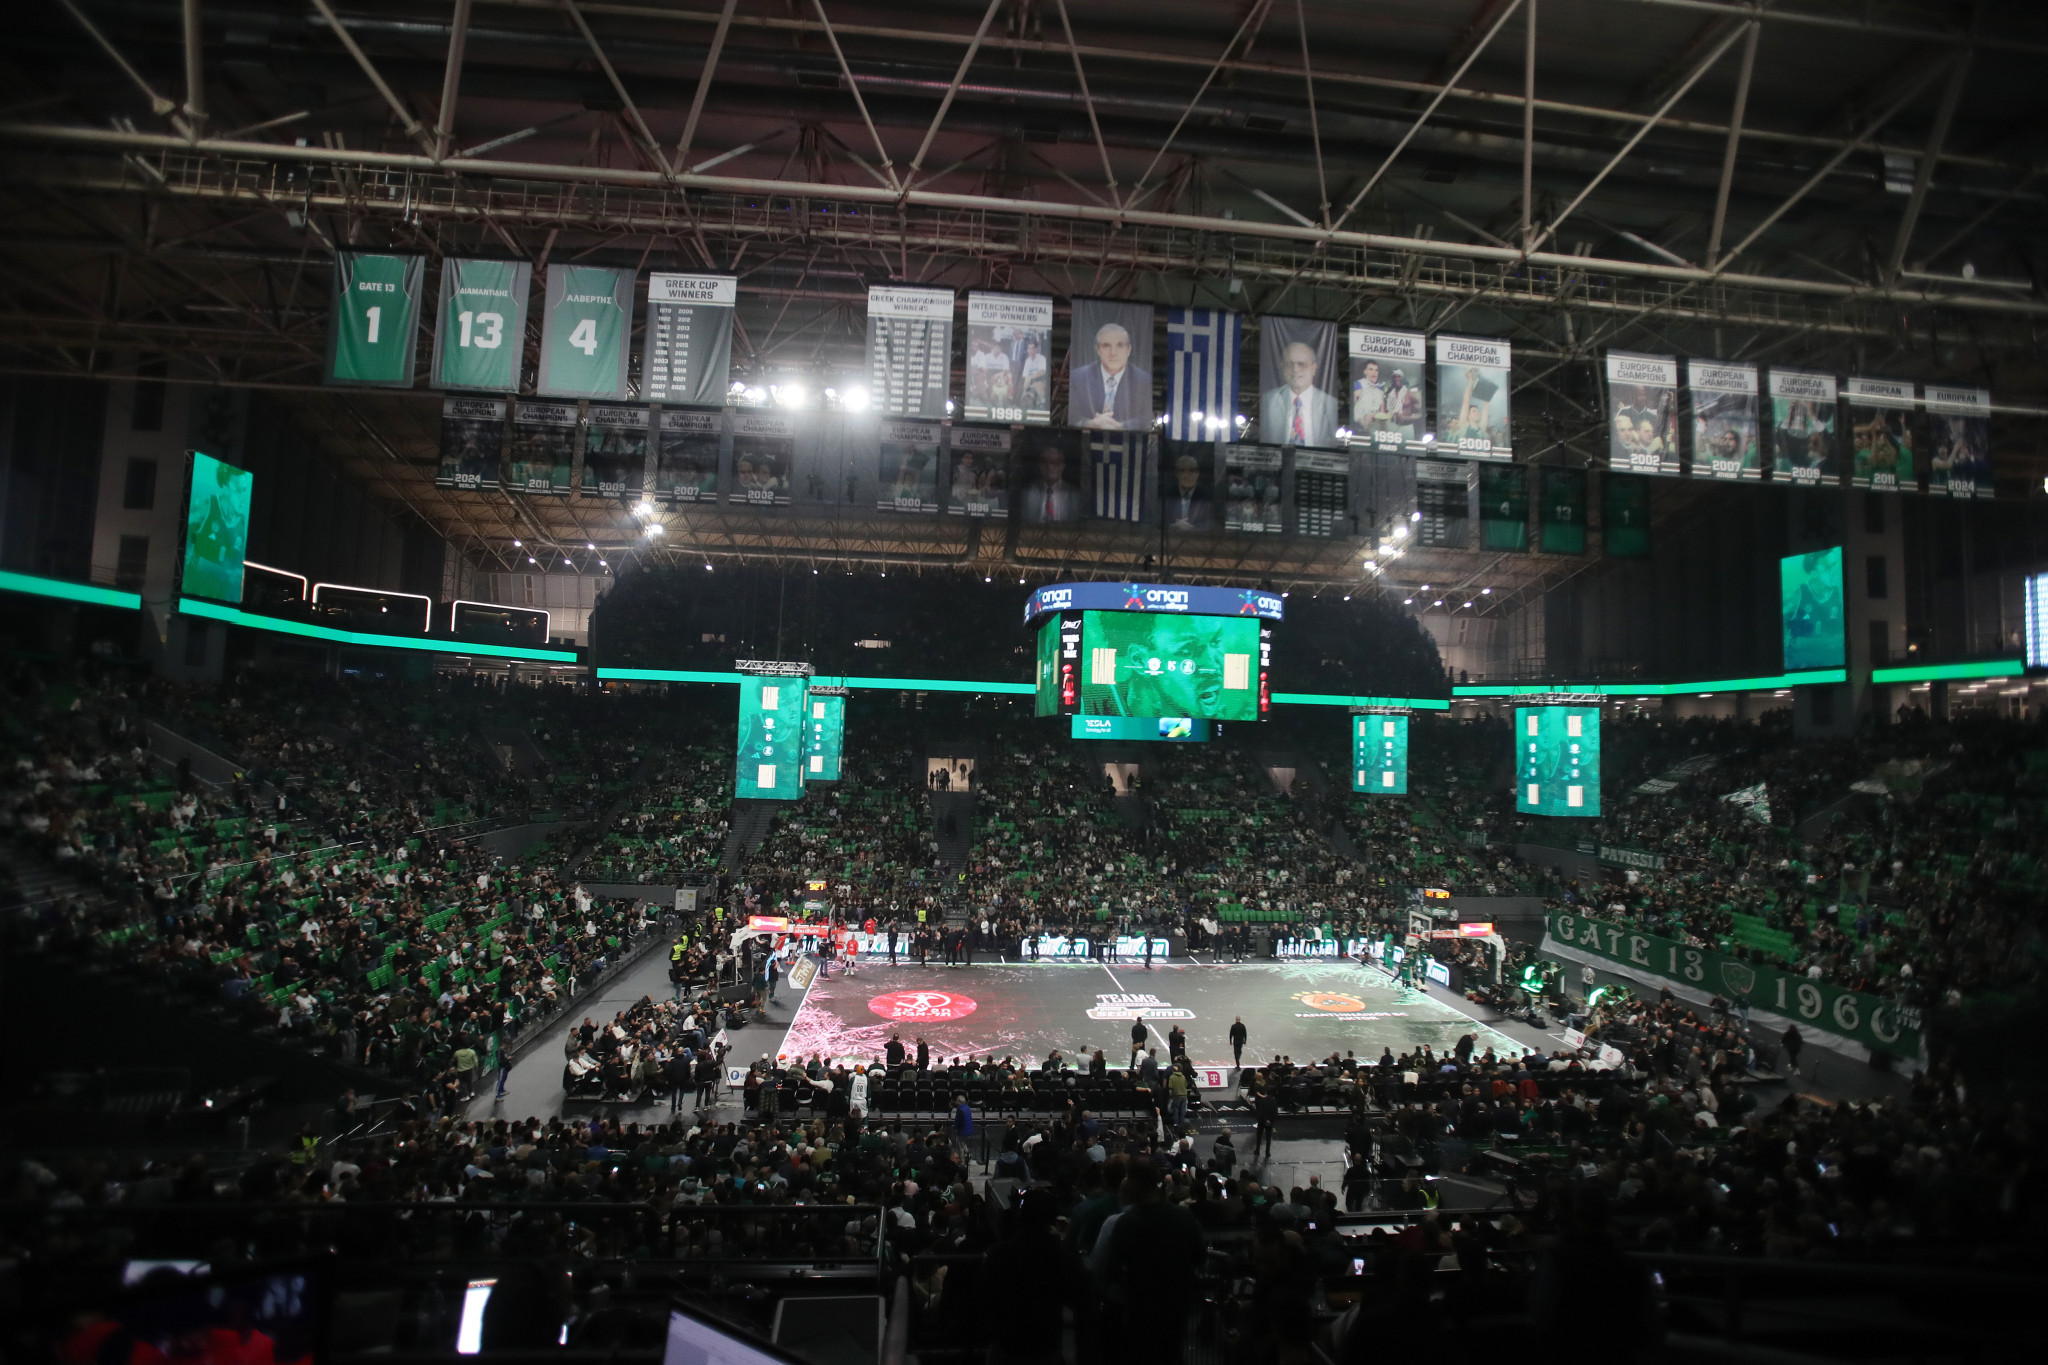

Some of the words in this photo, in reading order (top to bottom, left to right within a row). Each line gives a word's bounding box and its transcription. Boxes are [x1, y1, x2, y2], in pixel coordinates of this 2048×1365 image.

[358, 282, 383, 292] GATE
[384, 283, 395, 293] 13
[665, 279, 696, 289] GREEK
[699, 281, 718, 290] CUP
[668, 289, 714, 299] WINNERS
[893, 303, 929, 312] WINNERS
[971, 302, 1048, 314] INTERCONTINENTAL
[981, 311, 998, 319] CUP
[1000, 312, 1038, 321] WINNERS
[366, 306, 381, 344] 1
[458, 310, 504, 349] 13
[568, 319, 598, 355] 4
[1364, 335, 1412, 348] EUROPEAN
[1360, 343, 1415, 357] CHAMPIONS
[1450, 343, 1497, 355] EUROPEAN
[1447, 351, 1500, 365] CHAMPIONS
[1620, 361, 1664, 373] EUROPEAN
[1617, 370, 1667, 382] CHAMPIONS
[1702, 369, 1745, 381] EUROPEAN
[1699, 377, 1748, 389] CHAMPIONS
[1782, 377, 1824, 388] EUROPEAN
[1779, 385, 1827, 397] CHAMPIONS
[1860, 383, 1902, 395] EUROPEAN
[1936, 392, 1977, 404] EUROPEAN
[455, 400, 495, 410] EUROPEAN
[526, 405, 567, 416] EUROPEAN
[452, 407, 497, 417] CHAMPIONS
[522, 412, 569, 422] CHAMPIONS
[599, 409, 638, 418] EUROPEAN
[991, 407, 1022, 420] 1996
[595, 416, 640, 425] CHAMPIONS
[672, 414, 711, 423] EUROPEAN
[746, 418, 785, 427] EUROPEAN
[668, 421, 713, 430] CHAMPIONS
[743, 425, 787, 434] CHAMPIONS
[892, 427, 931, 435] EUROPEAN
[889, 433, 933, 442] CHAMPIONS
[961, 432, 1000, 441] EUROPEAN
[1374, 430, 1403, 444] 1996
[959, 438, 1002, 448] CHAMPIONS
[1379, 443, 1398, 452] PARIS
[1458, 438, 1491, 450] 2000
[1630, 453, 1660, 466] 2002
[1712, 460, 1742, 472] 2007
[1716, 471, 1738, 479] ATHENS
[1791, 466, 1821, 479] 2009
[454, 473, 481, 484] 2024
[528, 478, 550, 489] 2011
[1873, 472, 1896, 486] 2011
[599, 481, 626, 492] 2009
[673, 486, 700, 496] 2007
[1948, 480, 1975, 493] 2024
[747, 490, 774, 500] 2002
[1952, 491, 1971, 499] BERLIN
[894, 498, 921, 507] 2000
[967, 502, 990, 512] 1996
[1500, 501, 1511, 516] 4
[1555, 505, 1572, 521] 13
[1623, 509, 1630, 524] 1
[1085, 719, 1112, 727] TESLA
[1600, 846, 1665, 869] PATISSIA
[1557, 915, 1651, 967] GATE
[1667, 946, 1705, 982] 13
[1096, 994, 1160, 1003] TEAMS
